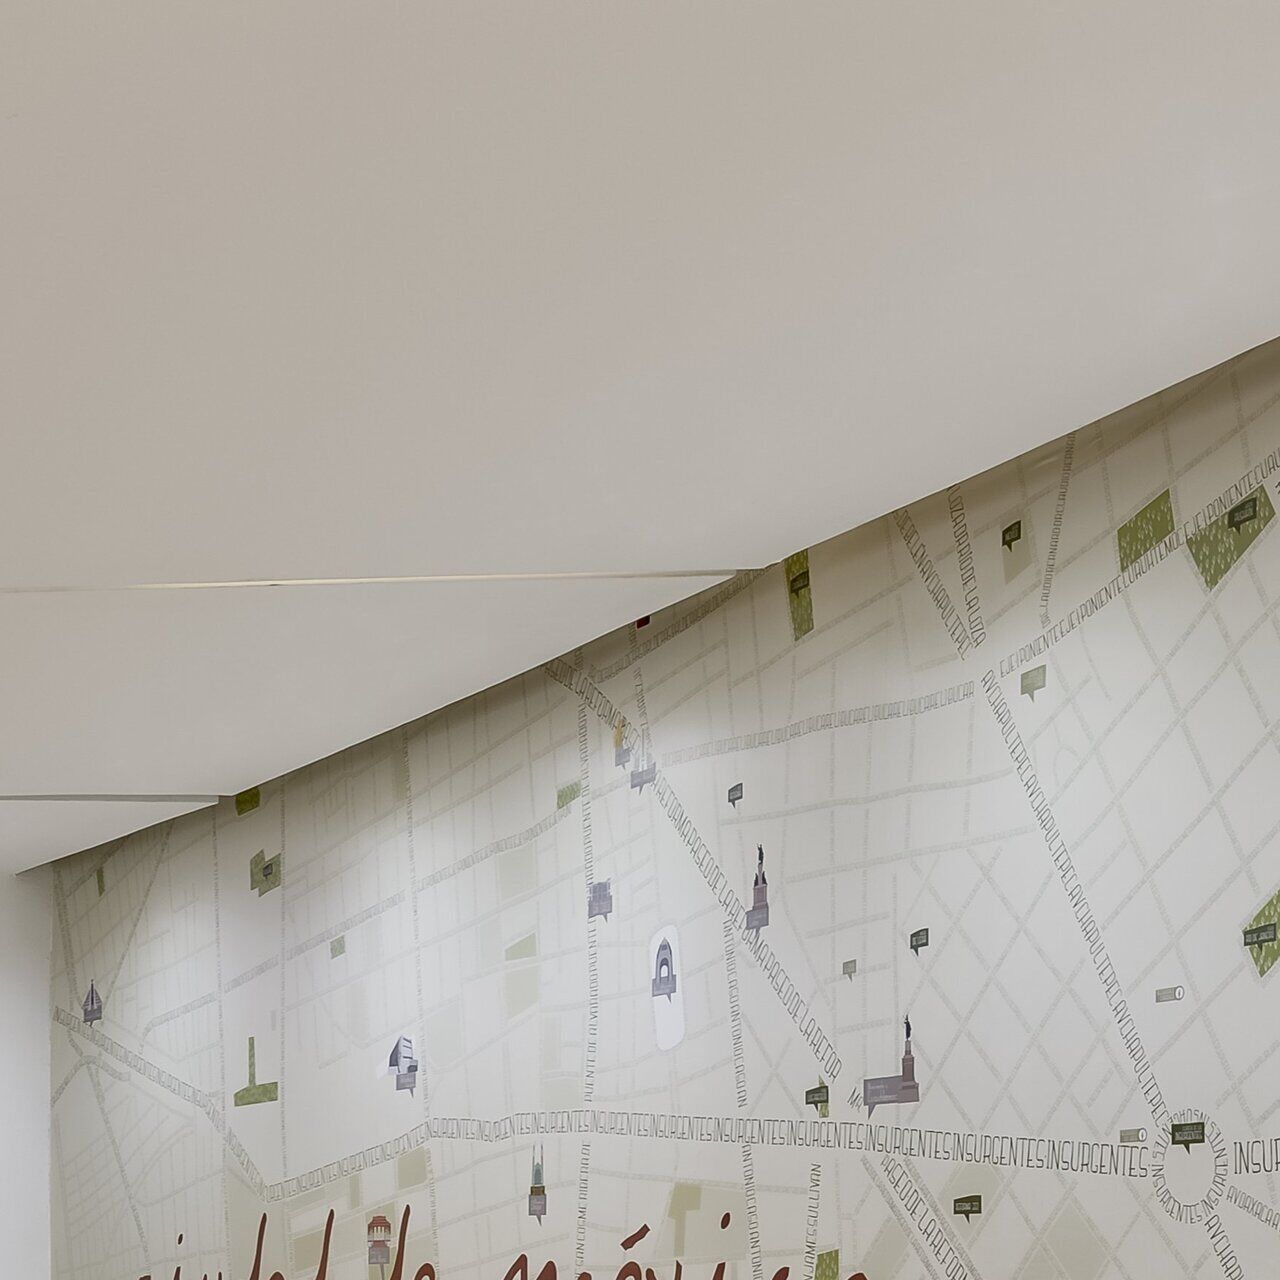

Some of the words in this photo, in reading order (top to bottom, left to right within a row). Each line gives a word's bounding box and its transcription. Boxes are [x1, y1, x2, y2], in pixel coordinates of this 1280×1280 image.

[1030, 787, 1077, 892] CHAPULTEPEC
[1075, 898, 1125, 1006] CHAPULTEPEC
[1120, 1017, 1171, 1127] CHAPULTEPEC
[652, 1113, 713, 1143] INSURGENTES
[714, 1116, 786, 1147] INSURGENTES
[786, 1118, 864, 1151] INSURGENTES
[865, 1123, 952, 1161] INSURGENTES
[952, 1131, 1044, 1169] INSURGENTES
[1045, 1138, 1148, 1178] INSURGENTES
